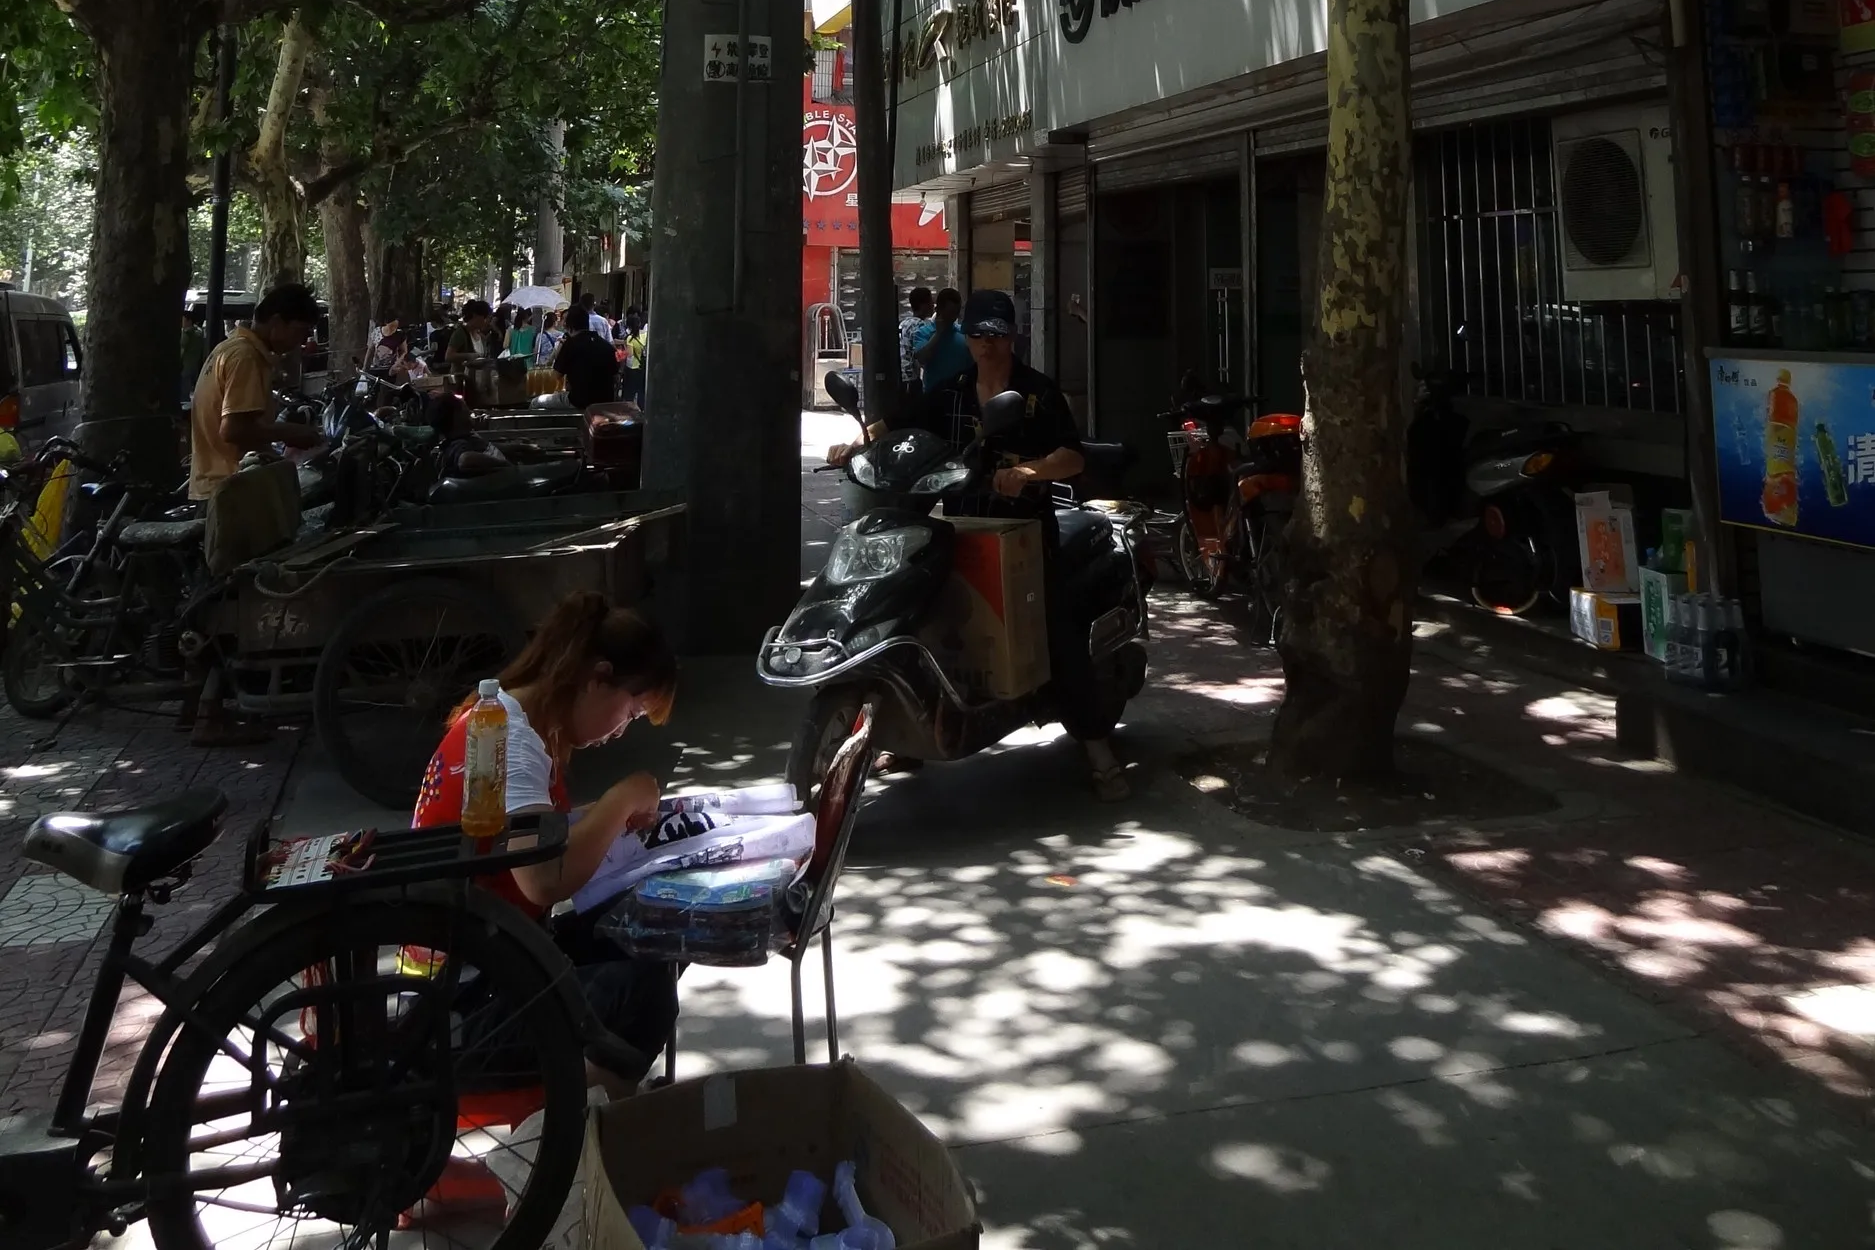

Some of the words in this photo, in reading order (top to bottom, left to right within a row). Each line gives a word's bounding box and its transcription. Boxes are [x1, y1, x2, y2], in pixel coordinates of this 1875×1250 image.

[726, 41, 769, 59] 禁攀登
[726, 61, 769, 81] 高危险
[1847, 432, 1875, 485] 清
